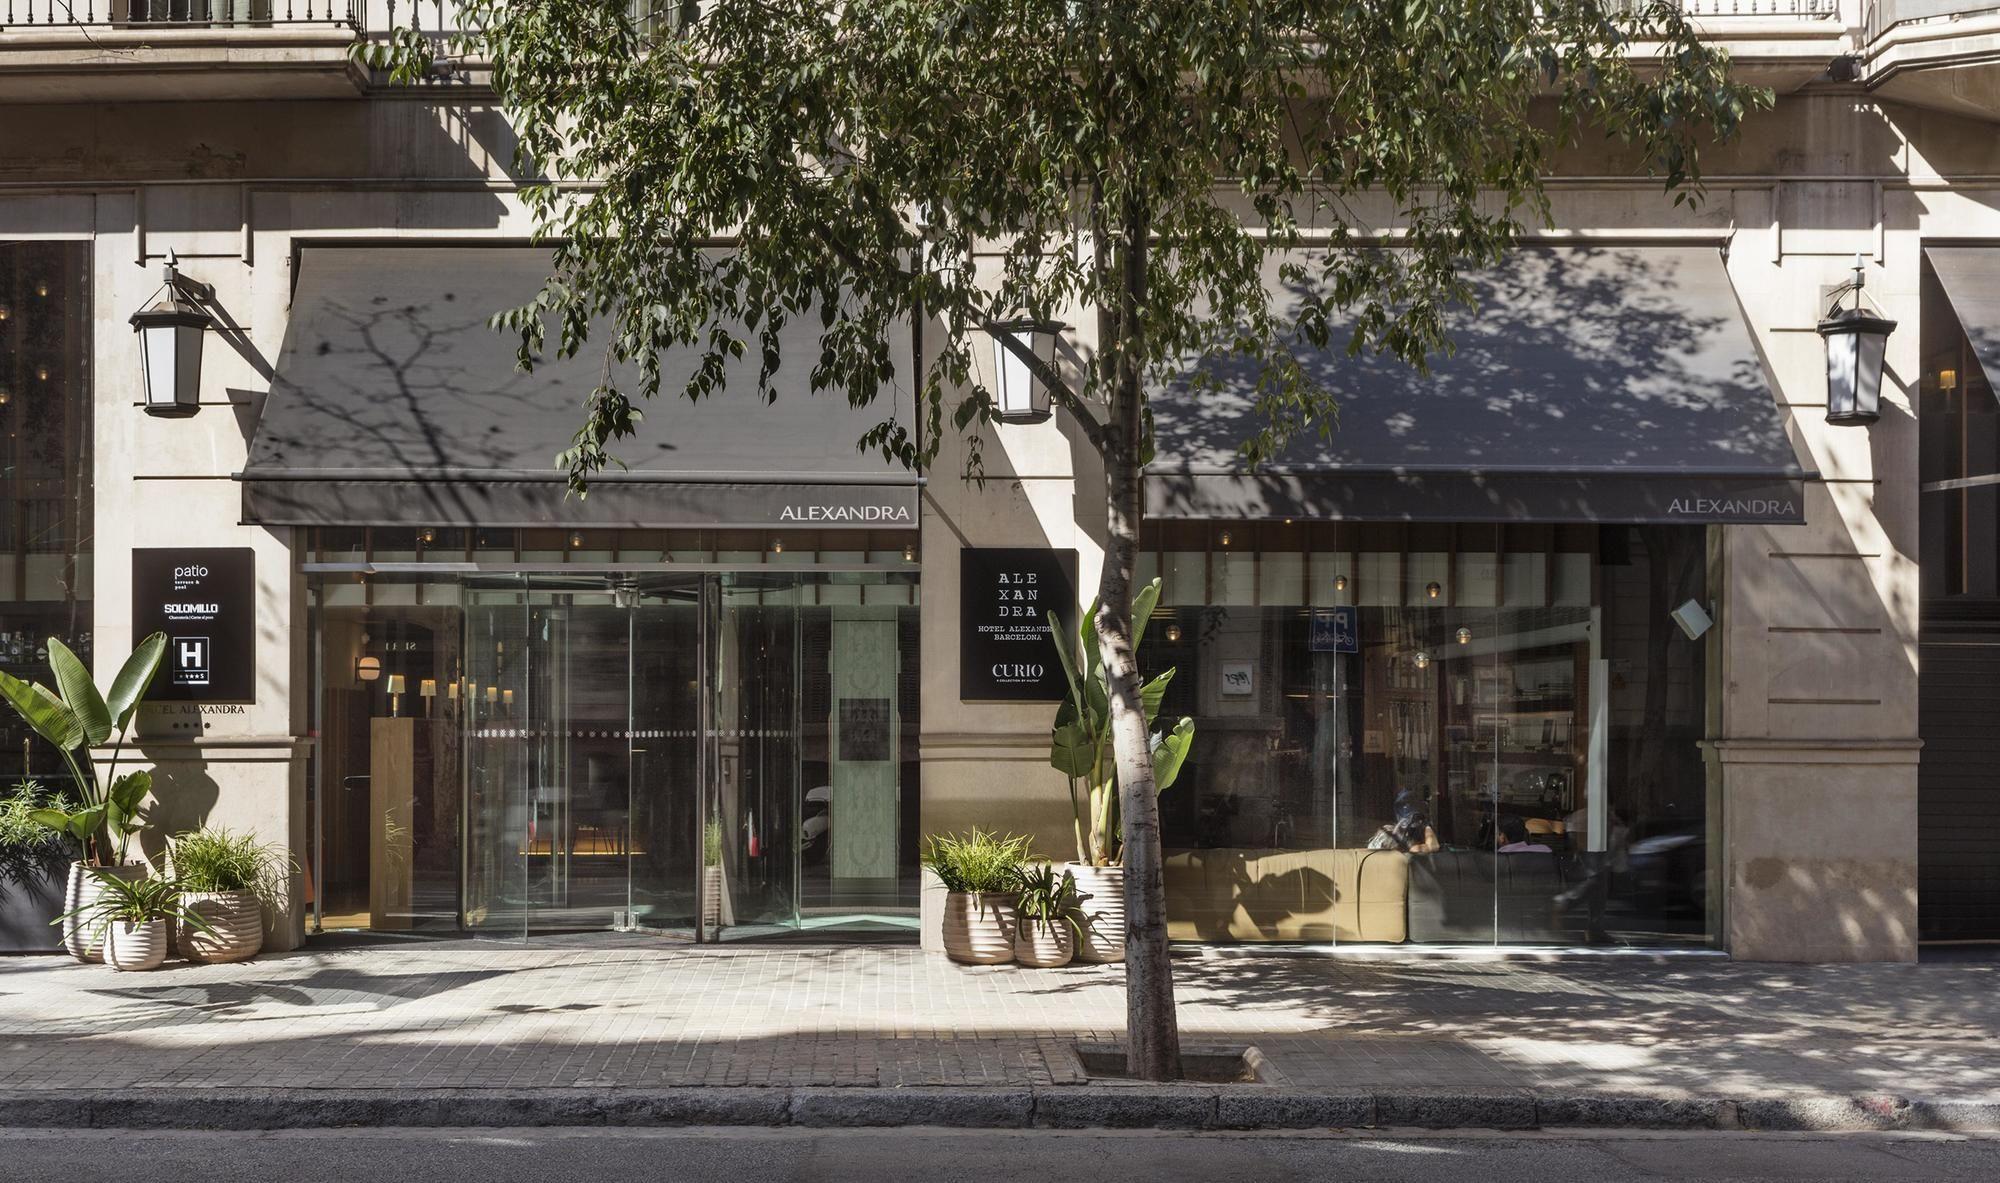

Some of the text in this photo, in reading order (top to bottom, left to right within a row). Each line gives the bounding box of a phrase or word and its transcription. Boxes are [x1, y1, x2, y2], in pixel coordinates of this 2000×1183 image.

[1668, 498, 1796, 515] ALEXANDRA
[780, 505, 910, 520] ALEXANDRA
[174, 564, 208, 580] patio
[998, 573, 1038, 584] ALE
[998, 589, 1039, 601] XAN
[164, 603, 219, 614] SOLOMILLO
[998, 606, 1038, 617] DRA
[978, 625, 1053, 633] HOTEL ALEXANDR
[994, 633, 1043, 641] BARCELONA
[180, 642, 202, 668] H
[992, 663, 1044, 677] CURIO
[181, 704, 245, 714] ALEXANDRA
